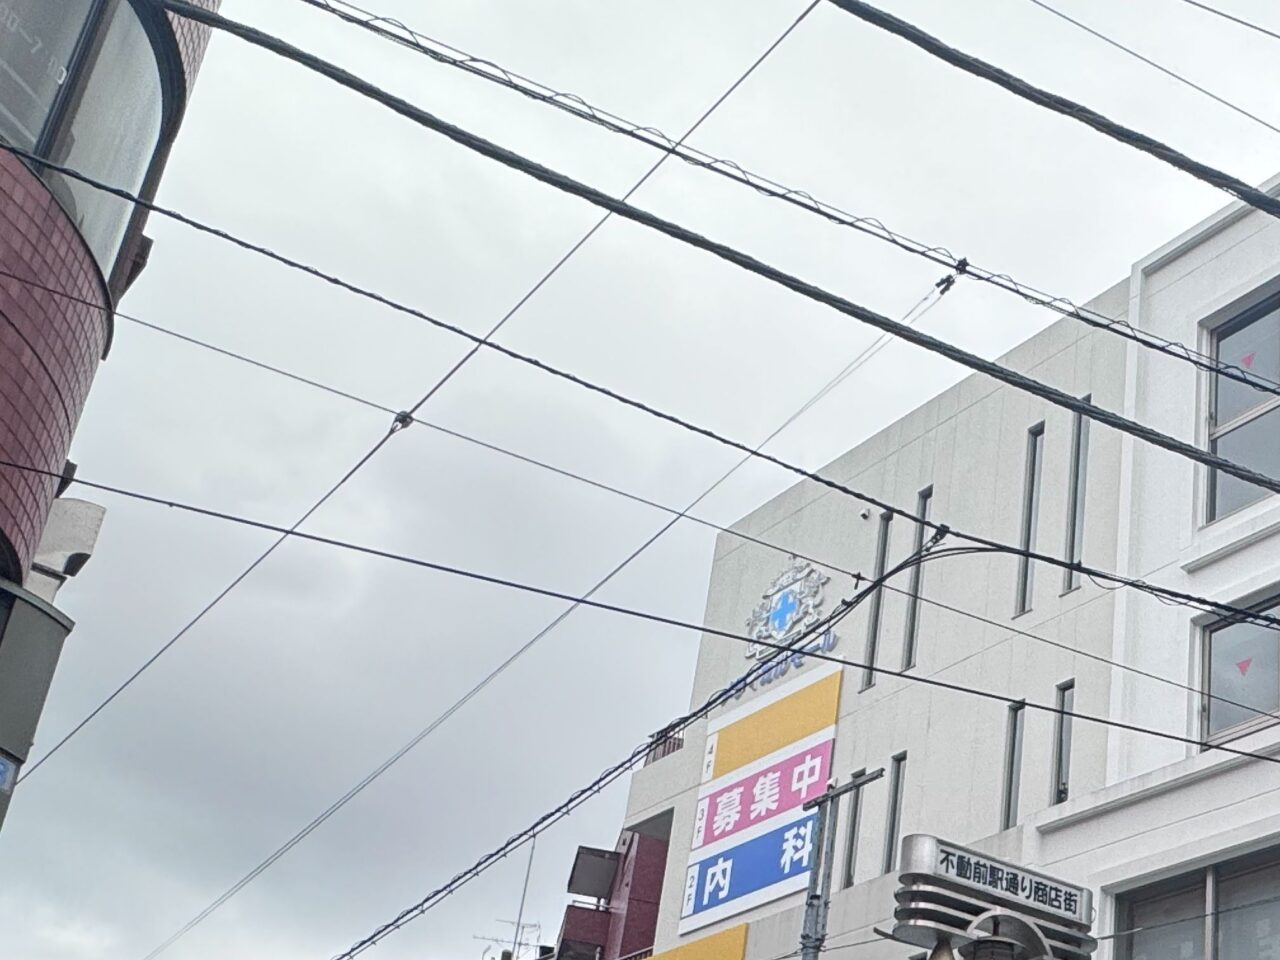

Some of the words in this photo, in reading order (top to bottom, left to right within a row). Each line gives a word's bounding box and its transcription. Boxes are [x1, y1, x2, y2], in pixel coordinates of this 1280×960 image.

[712, 754, 822, 834] 募集中
[702, 820, 813, 906] 内科
[939, 848, 1079, 916] 不動前駅通り商店街
